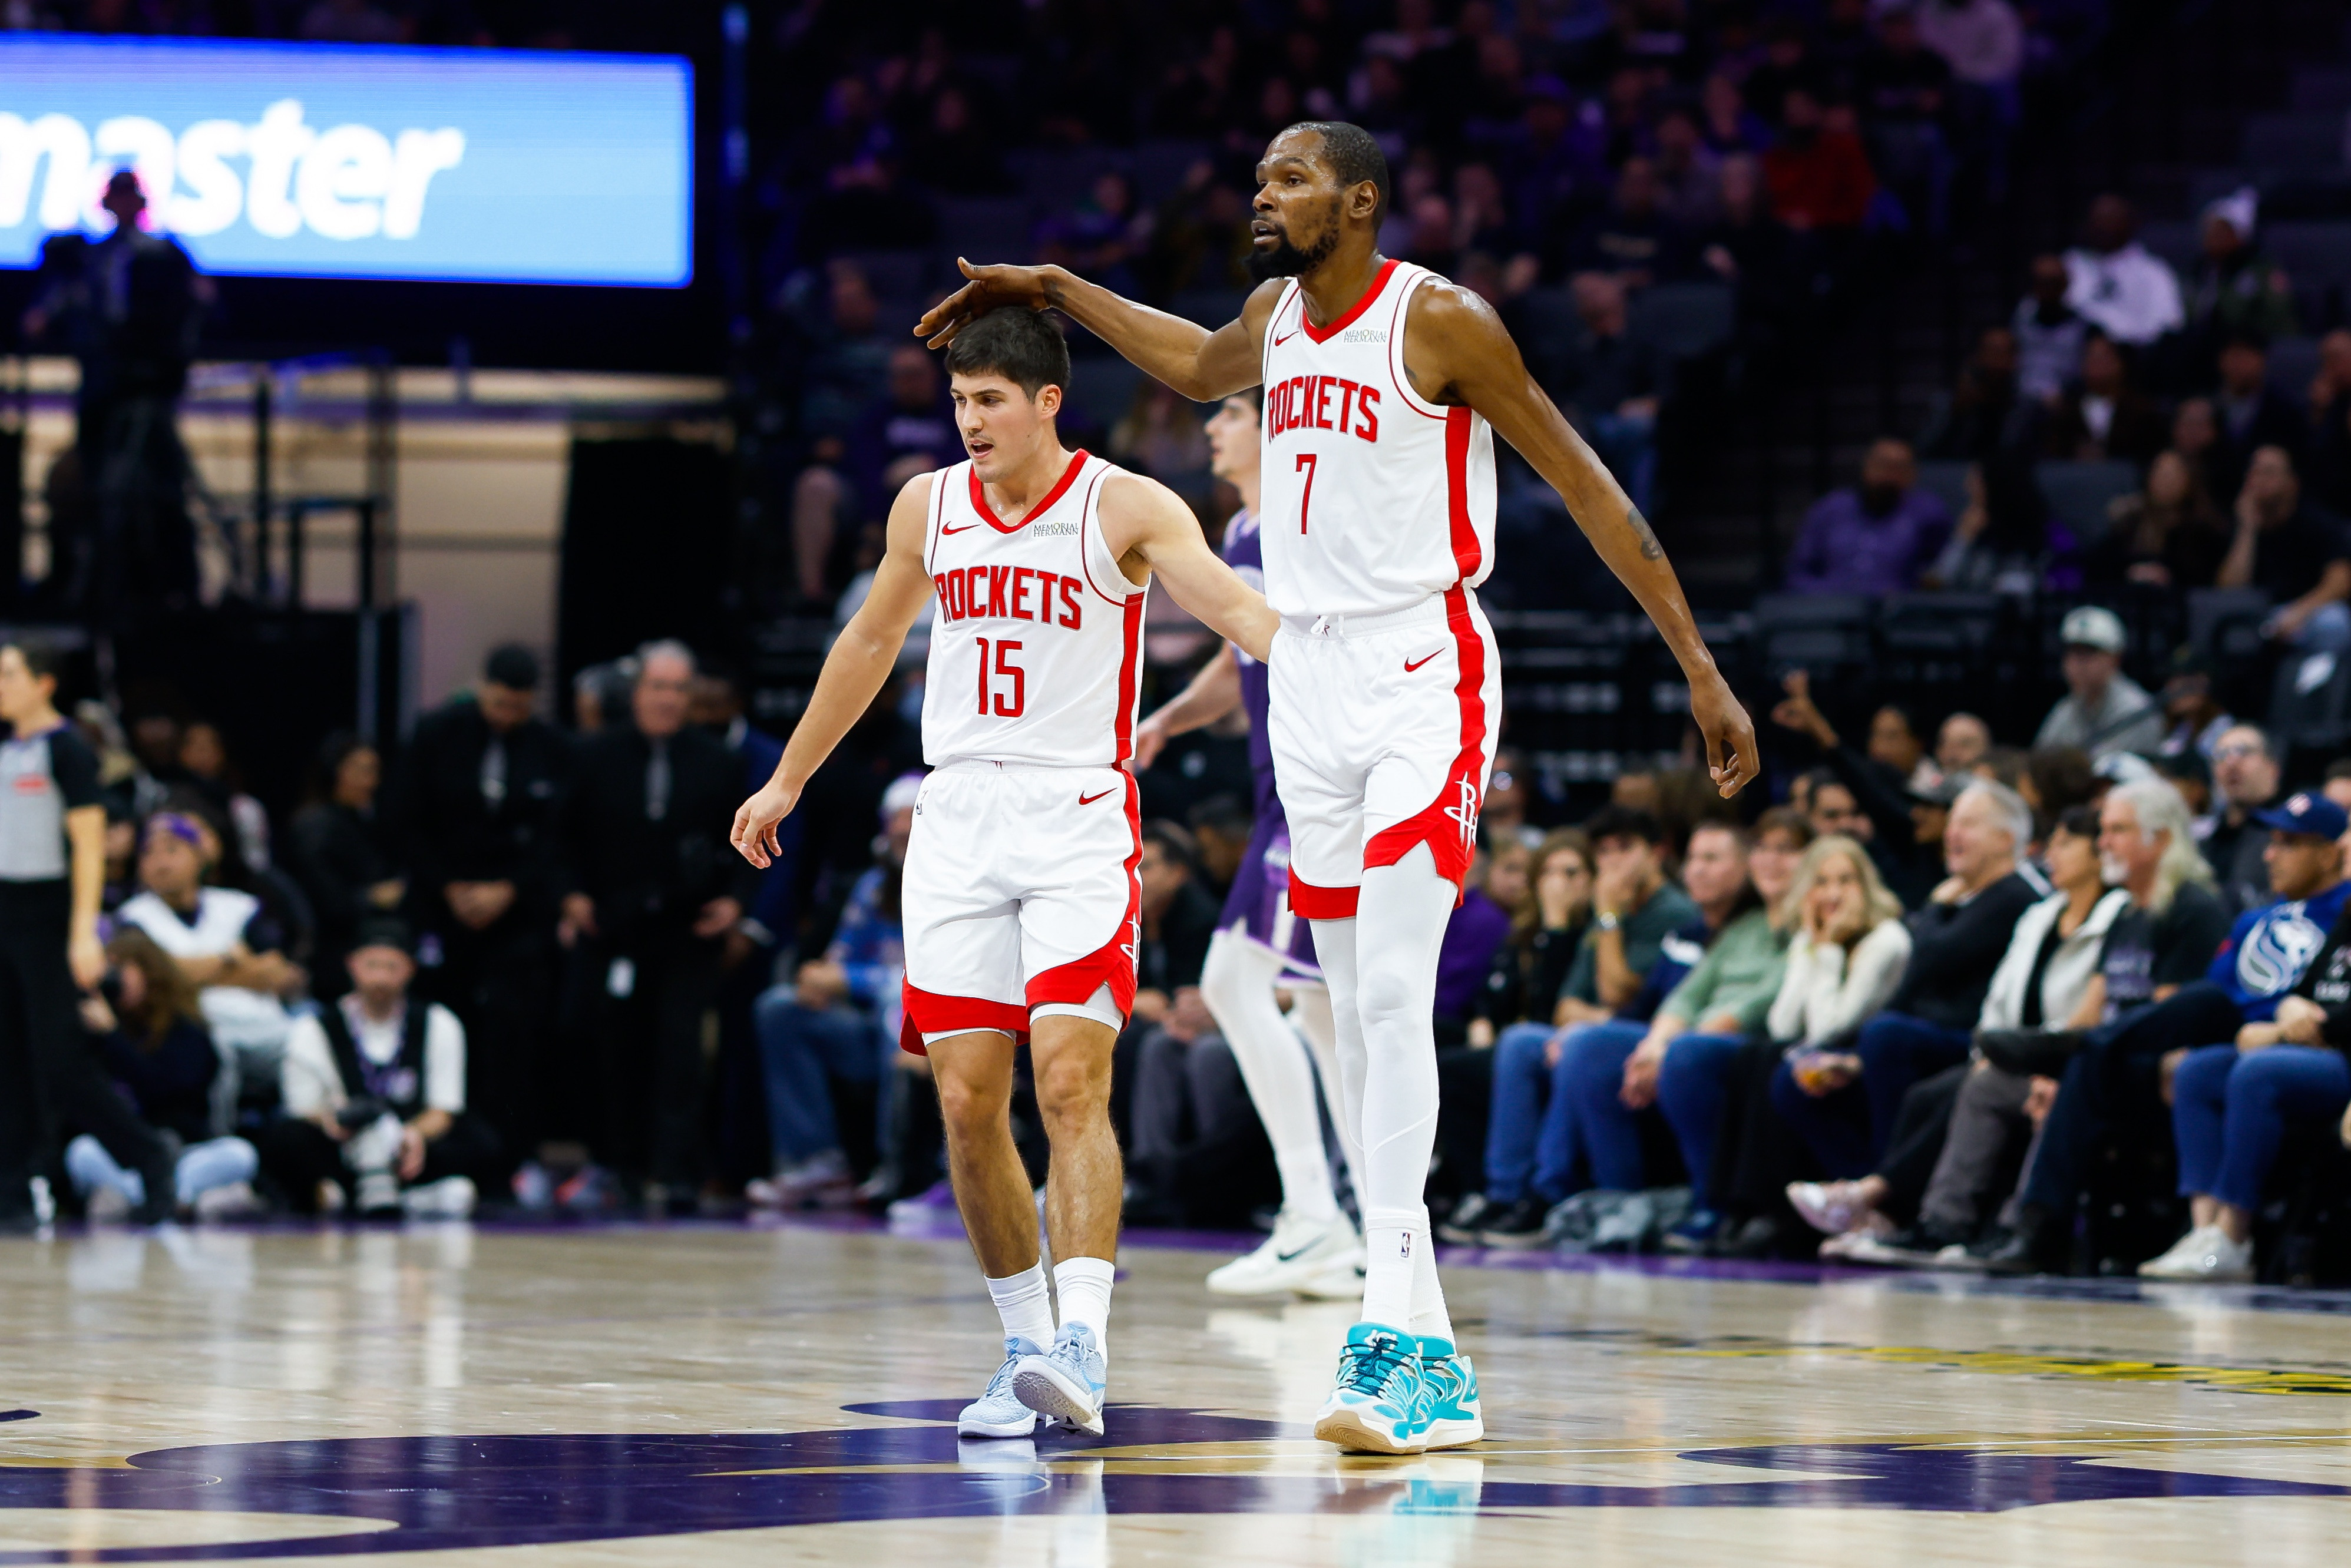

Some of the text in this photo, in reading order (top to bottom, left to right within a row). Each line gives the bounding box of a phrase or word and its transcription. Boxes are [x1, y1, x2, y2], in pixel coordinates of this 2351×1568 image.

[1345, 329, 1387, 338] MEMORIAL
[1268, 374, 1381, 445] ROCKETS
[1034, 523, 1079, 532] MEMORIAL
[1295, 454, 1317, 535] 7
[933, 565, 1084, 631] ROCKETS
[976, 637, 1025, 718] 15
